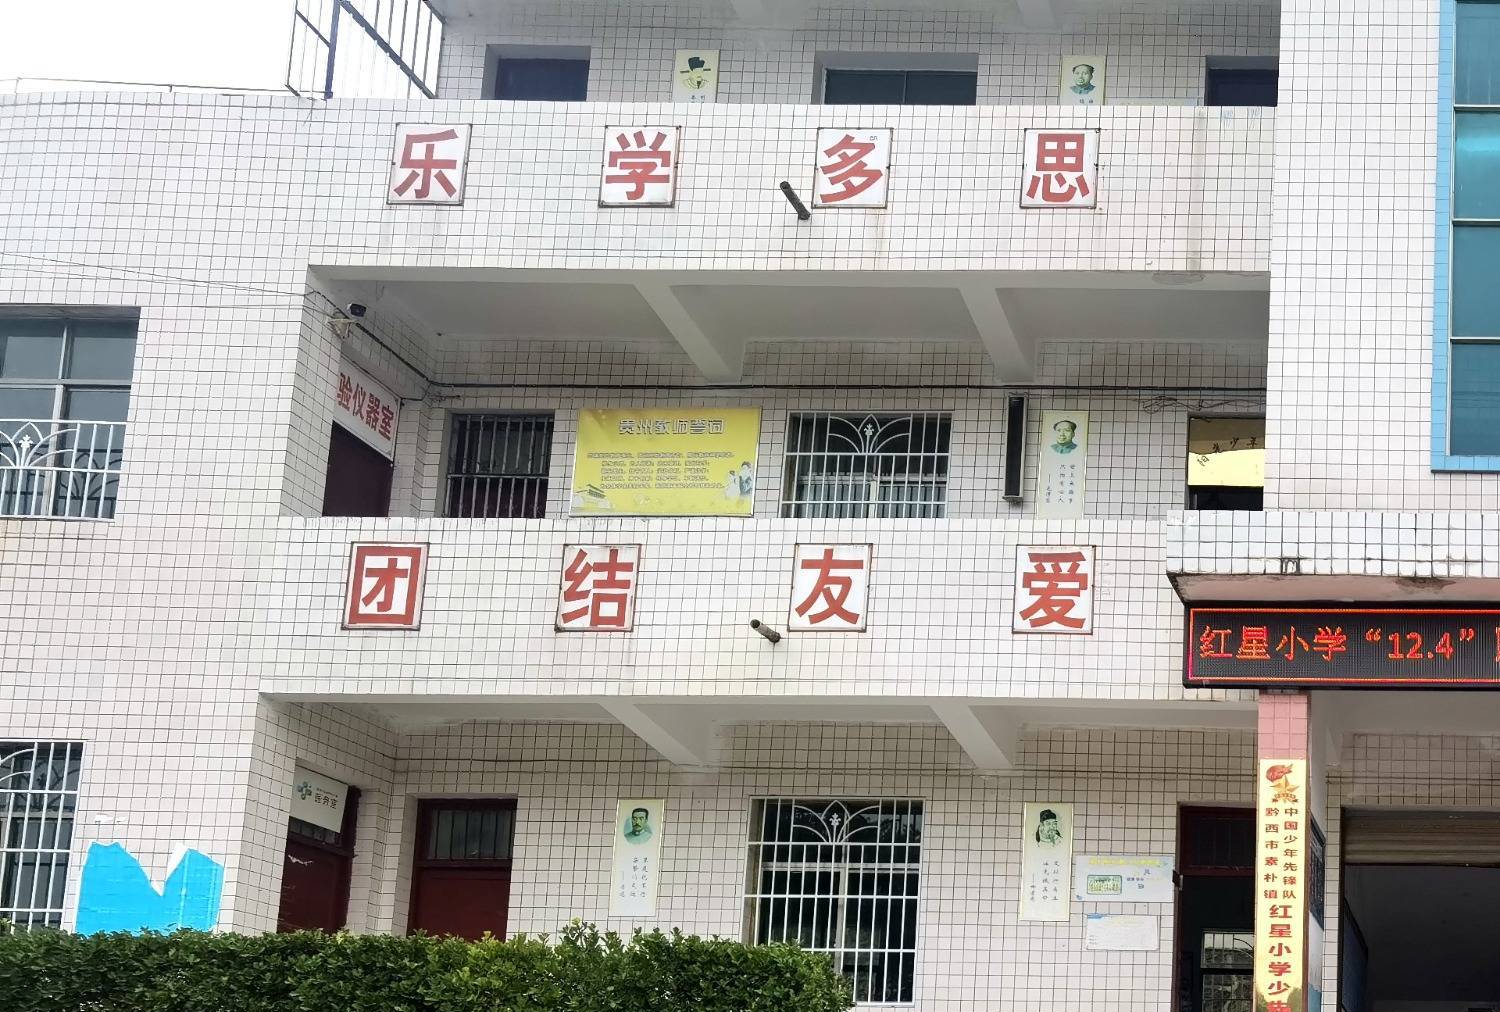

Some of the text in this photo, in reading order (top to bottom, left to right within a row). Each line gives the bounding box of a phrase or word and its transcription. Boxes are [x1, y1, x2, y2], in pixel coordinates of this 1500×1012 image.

[394, 129, 1089, 203] 乐学多思
[350, 548, 1089, 629] 团结友爱
[1283, 807, 1298, 900] 中国少年先锋队
